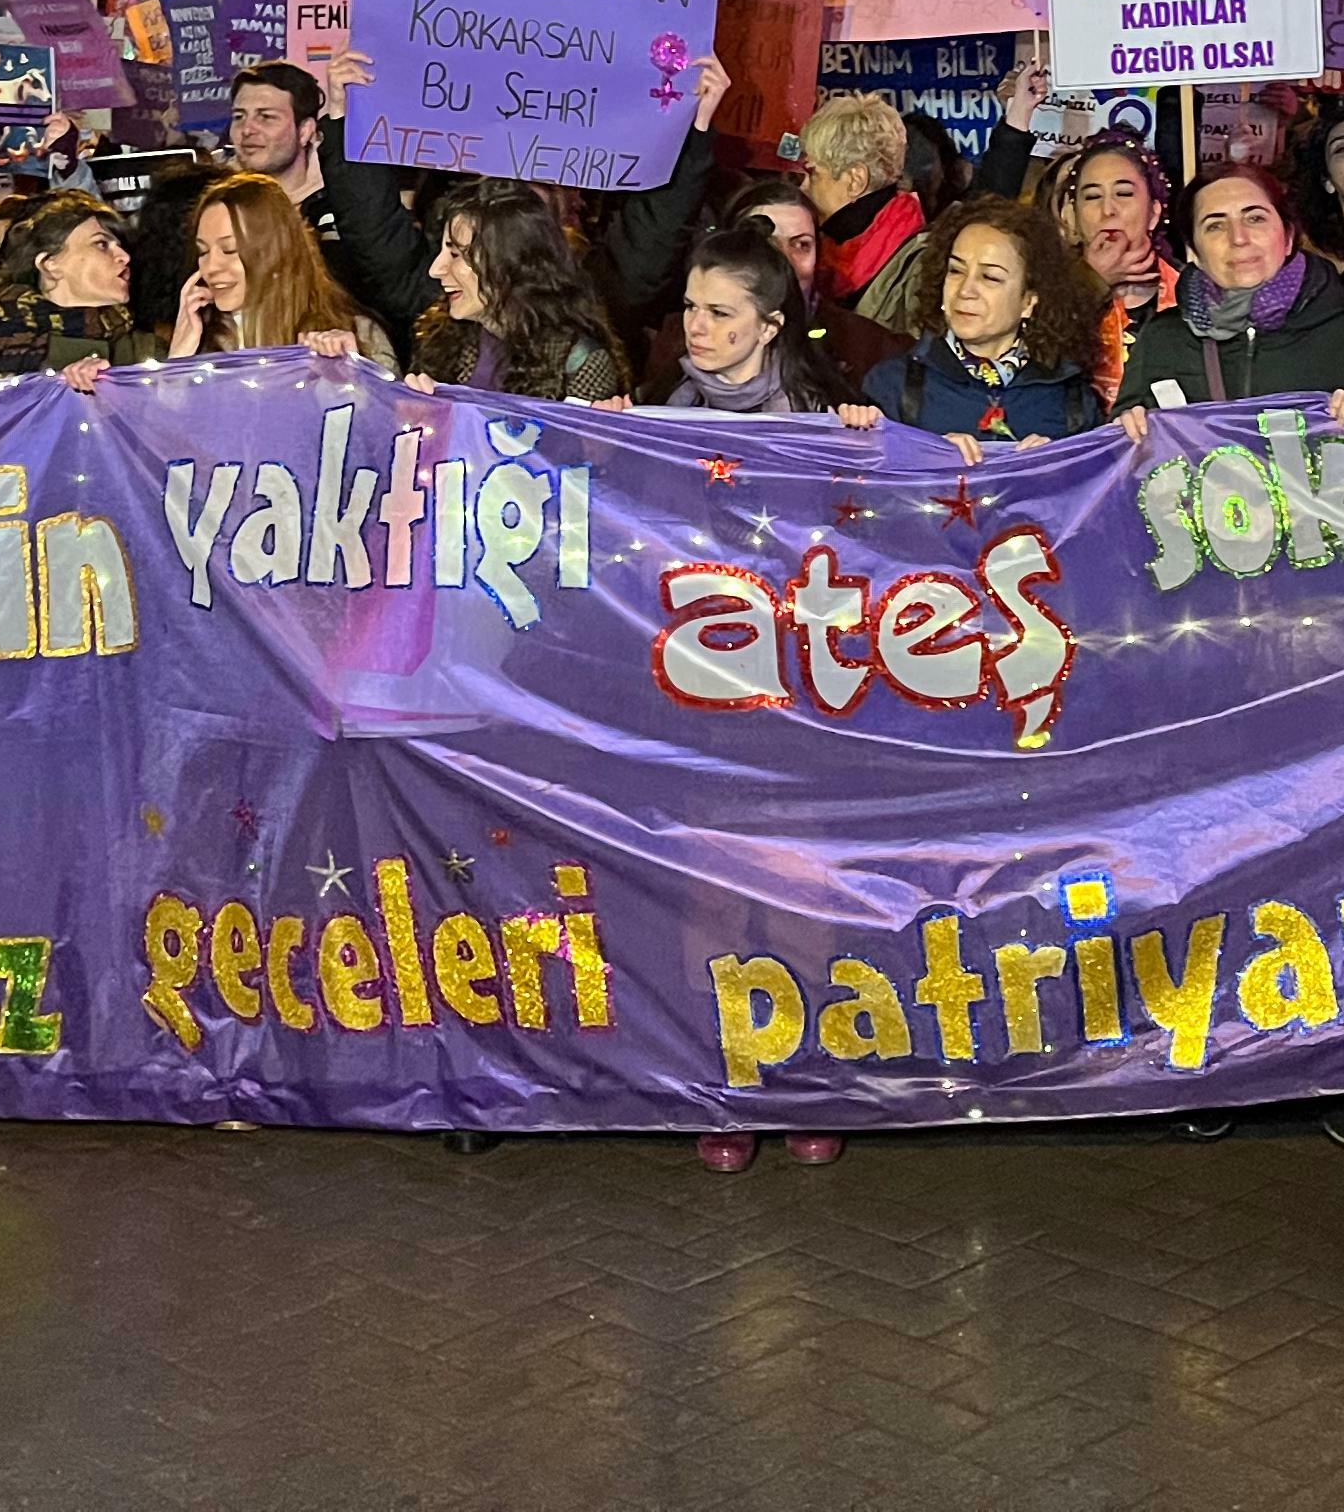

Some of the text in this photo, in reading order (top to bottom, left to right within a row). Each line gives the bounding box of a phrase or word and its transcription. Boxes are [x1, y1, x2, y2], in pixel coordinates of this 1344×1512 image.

[231, 18, 285, 35] YAMAN
[254, 2, 286, 19] YAR
[821, 39, 999, 79] BEYNİM BİLİR
[1110, 40, 1274, 75] ÖZGÜR OLSA!
[496, 71, 599, 128] ŞEHRİ
[506, 131, 642, 188] VERİRİZ
[163, 401, 593, 631] yaktığı
[653, 524, 1079, 750] ateş
[140, 856, 616, 1053] geceleri
